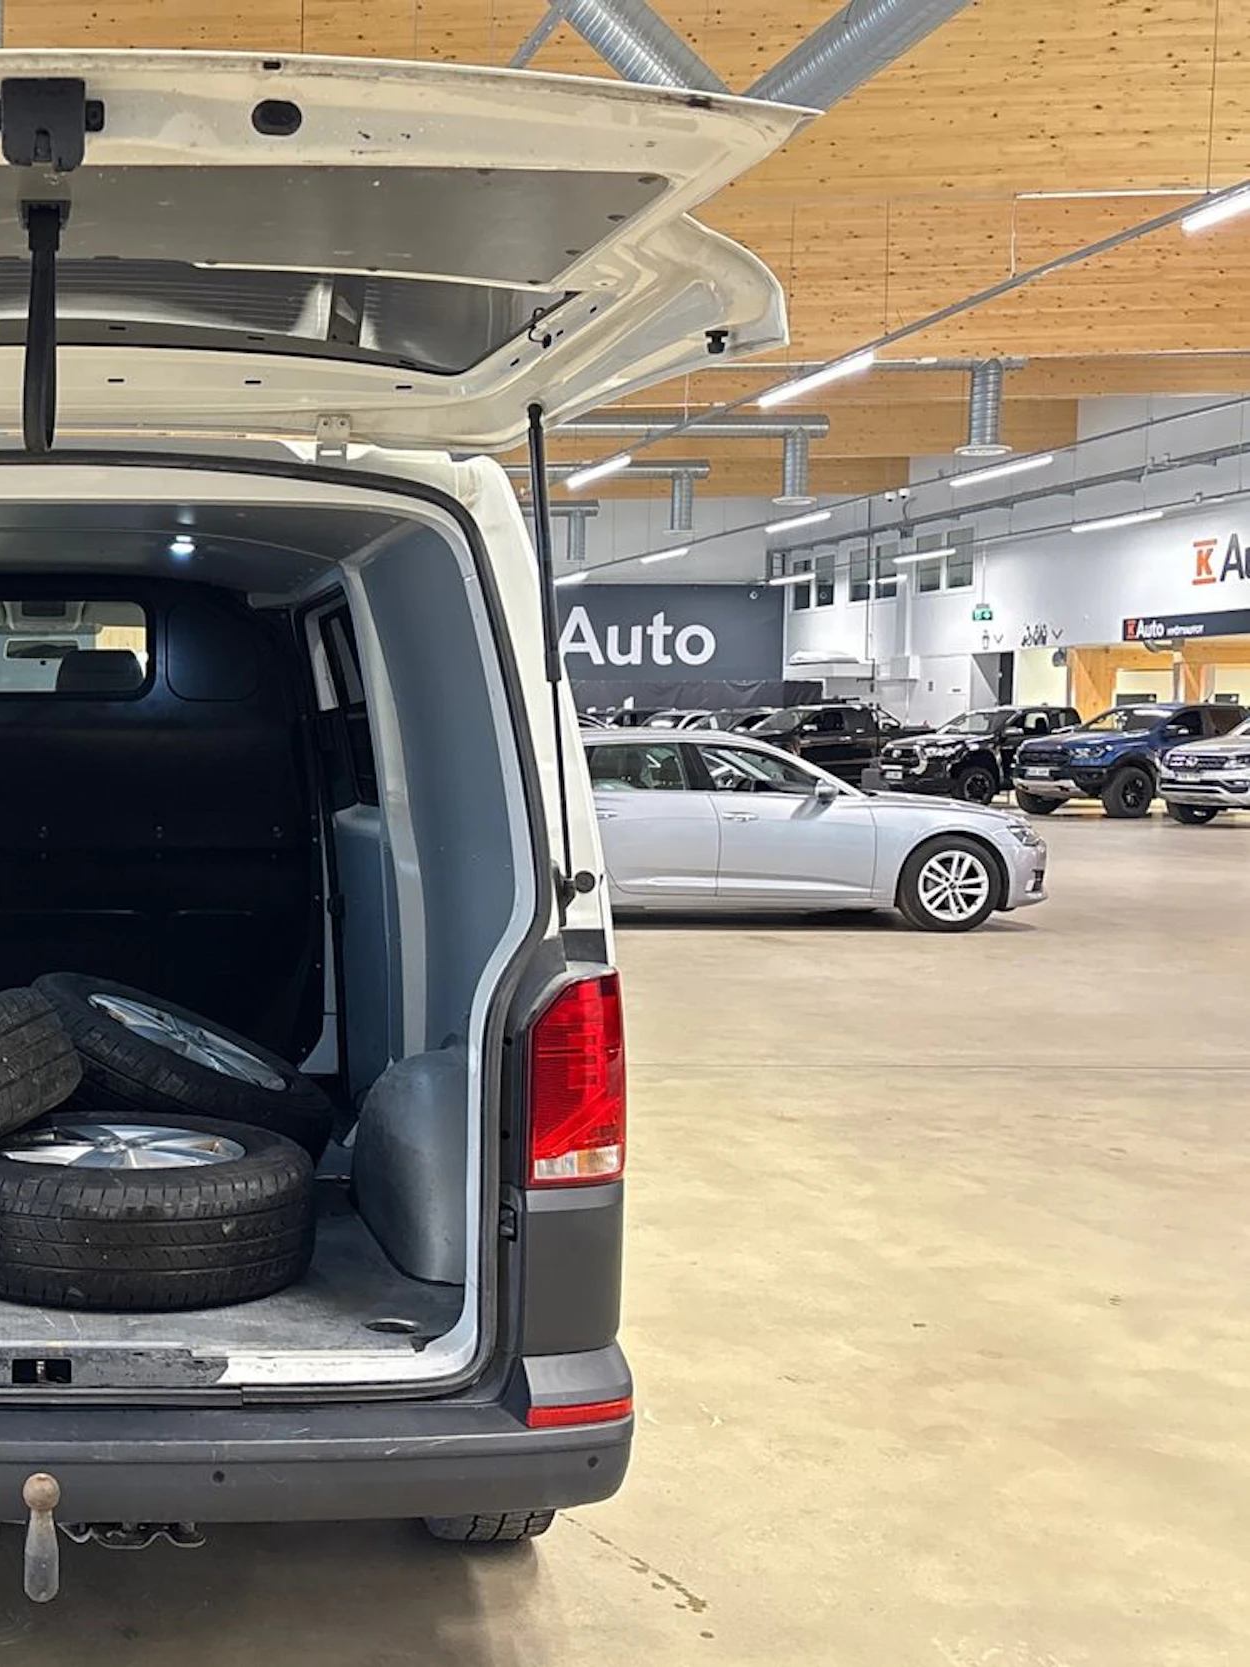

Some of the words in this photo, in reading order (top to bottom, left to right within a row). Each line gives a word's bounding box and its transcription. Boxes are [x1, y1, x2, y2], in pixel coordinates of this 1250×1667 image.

[1220, 533, 1250, 582] A
[558, 606, 716, 666] Auto
[1136, 620, 1165, 639] Auto
